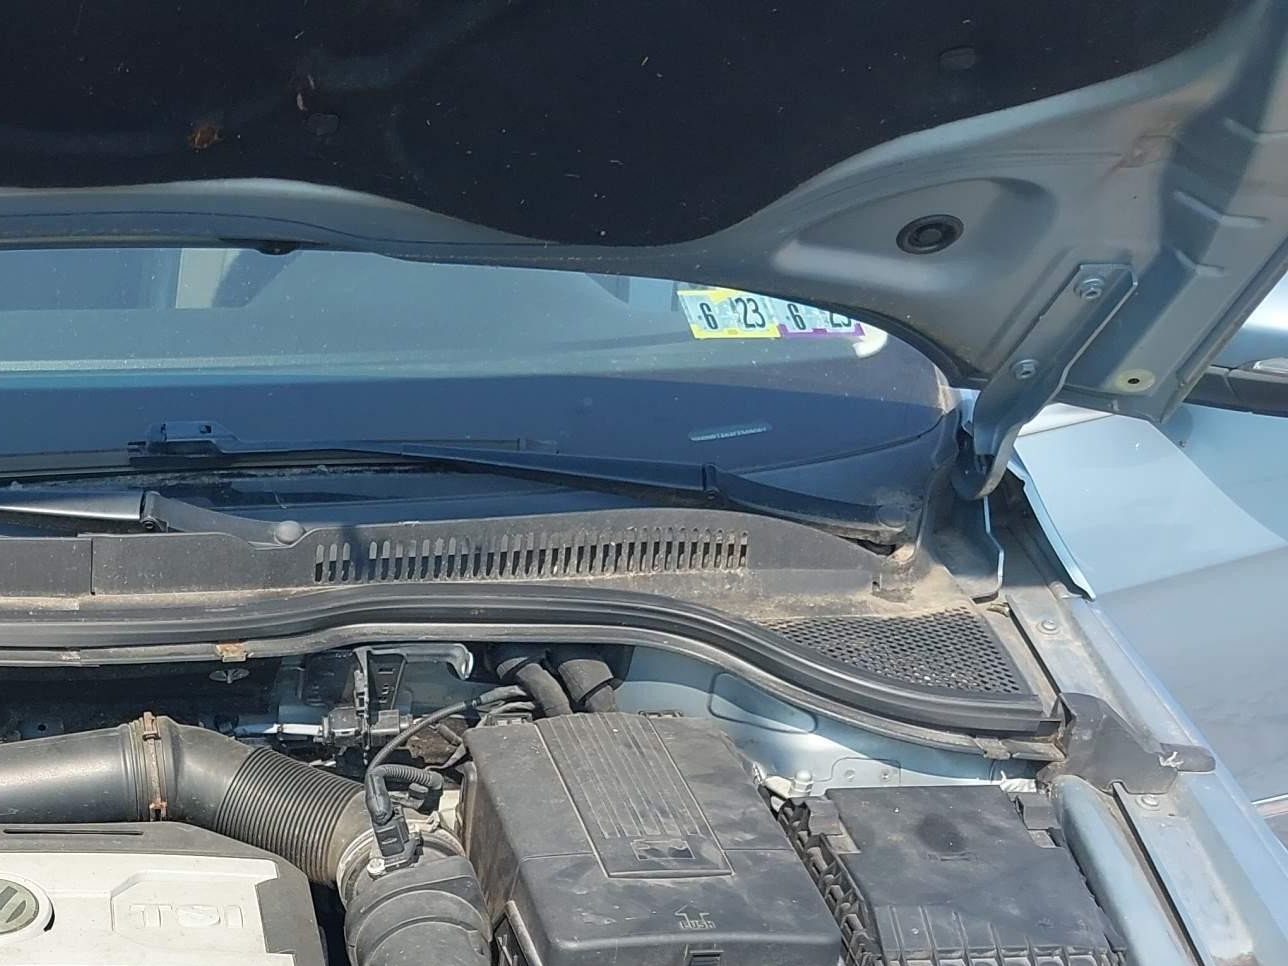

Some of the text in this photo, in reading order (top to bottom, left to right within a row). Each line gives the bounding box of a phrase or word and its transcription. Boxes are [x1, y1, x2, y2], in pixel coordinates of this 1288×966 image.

[699, 302, 719, 329] 6
[786, 303, 807, 330] 6
[128, 903, 245, 929] TSI
